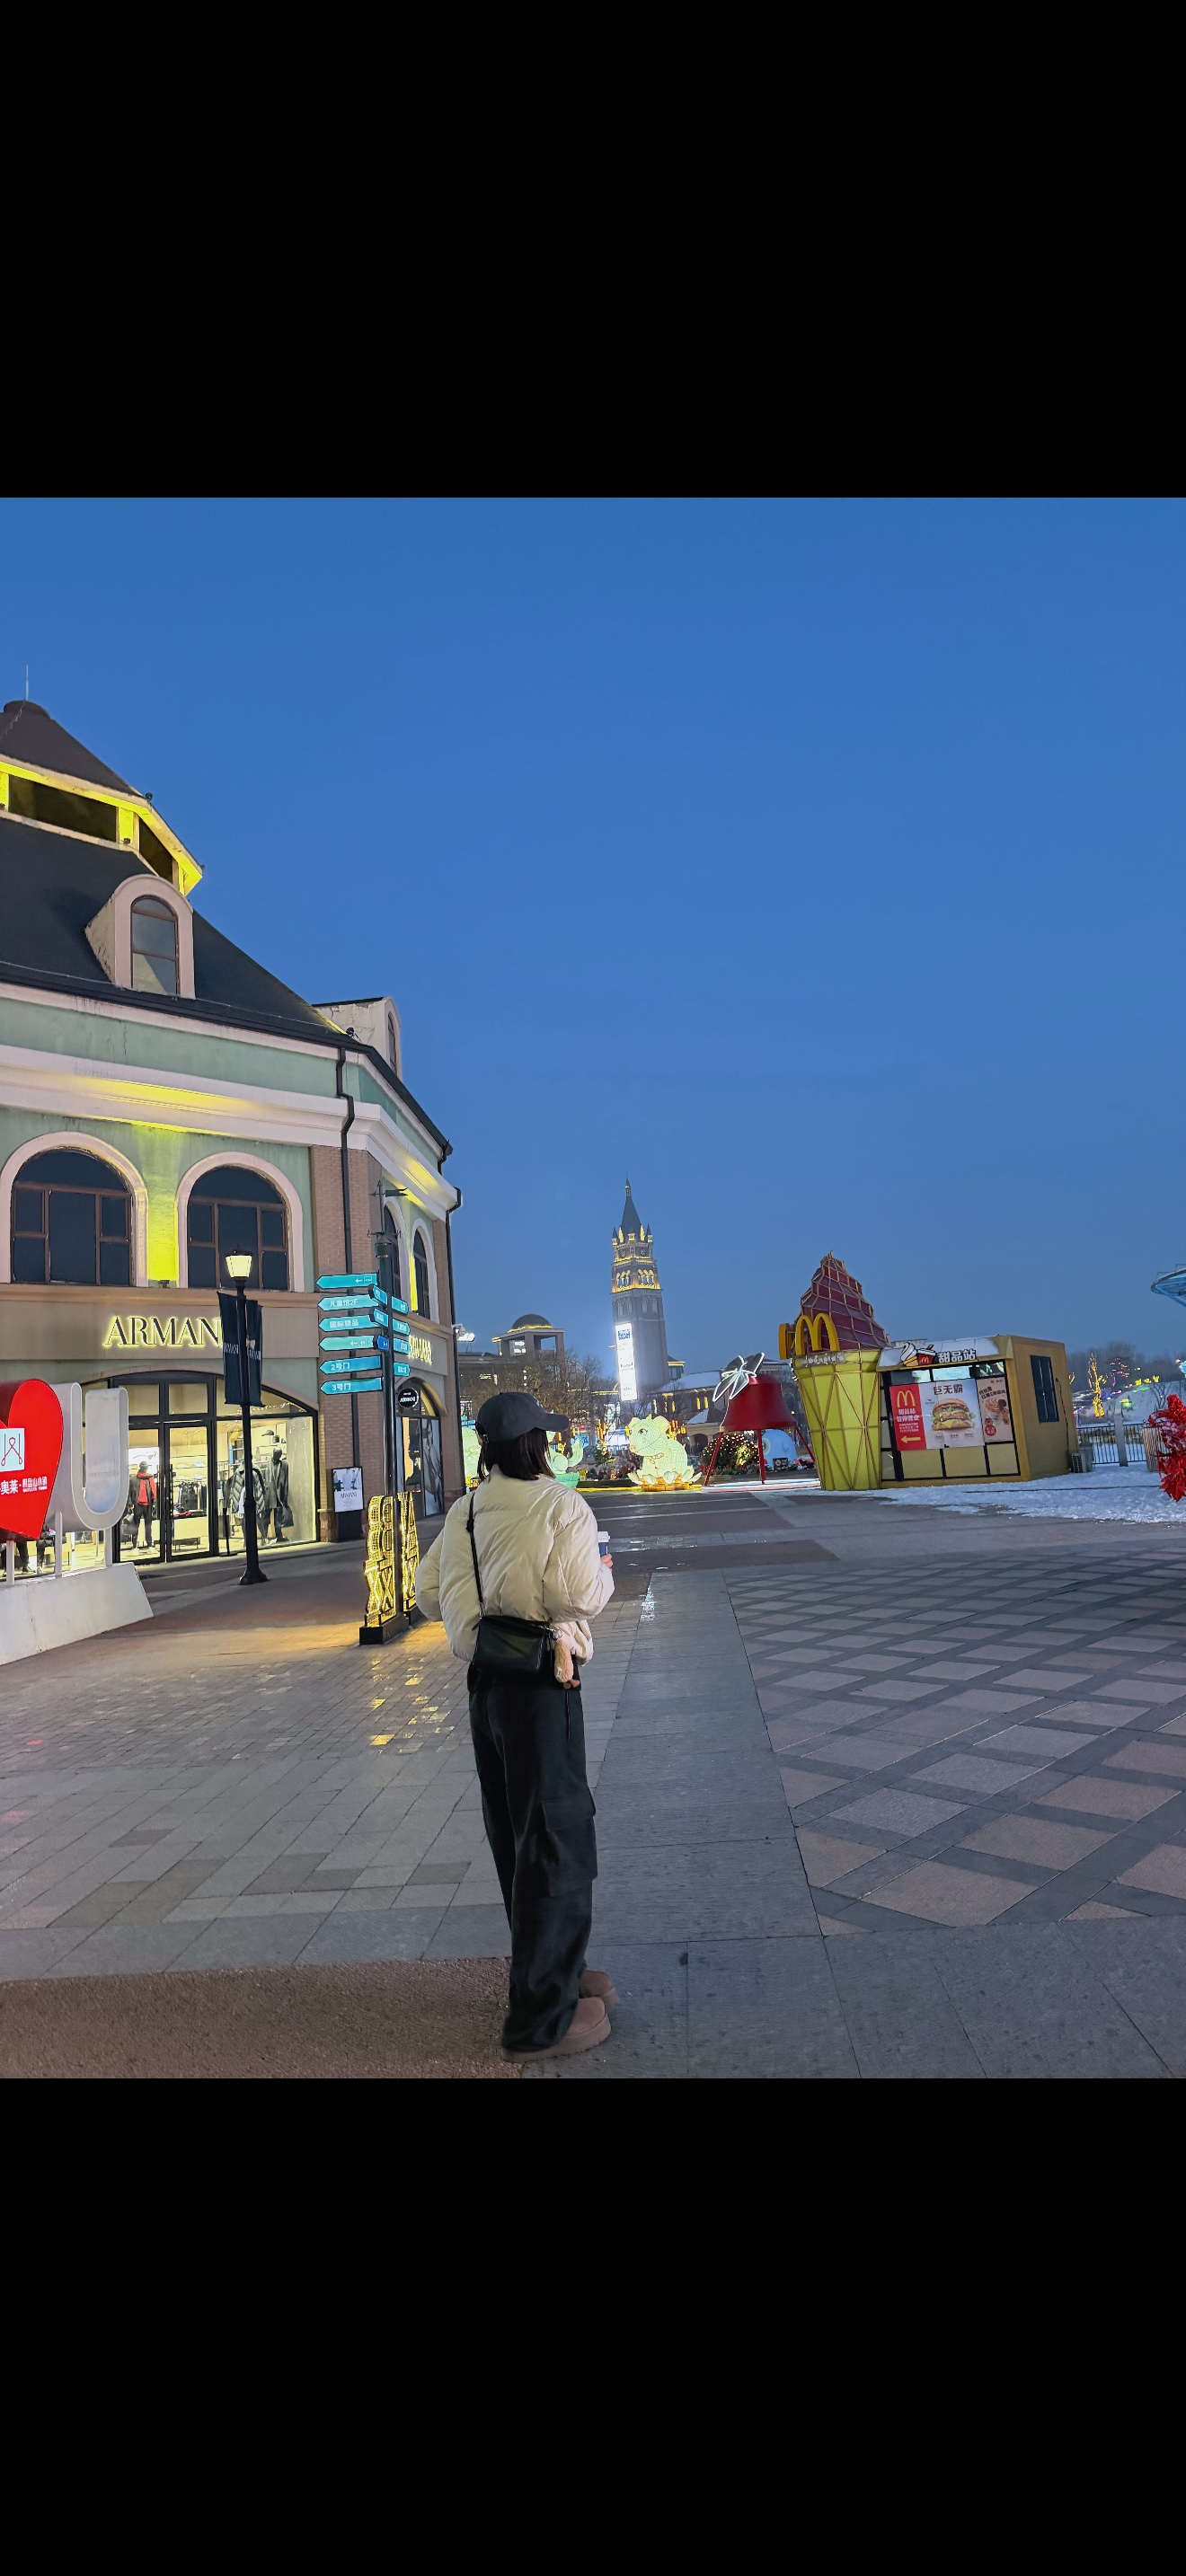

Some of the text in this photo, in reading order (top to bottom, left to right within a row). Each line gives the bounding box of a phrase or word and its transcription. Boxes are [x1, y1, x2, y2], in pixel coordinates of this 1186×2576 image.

[330, 1319, 359, 1328] 国际精品
[937, 1348, 977, 1363] 甜品站
[331, 1362, 350, 1371] 2号门
[332, 1383, 351, 1391] 3号门
[933, 1383, 963, 1396] 巨无霸
